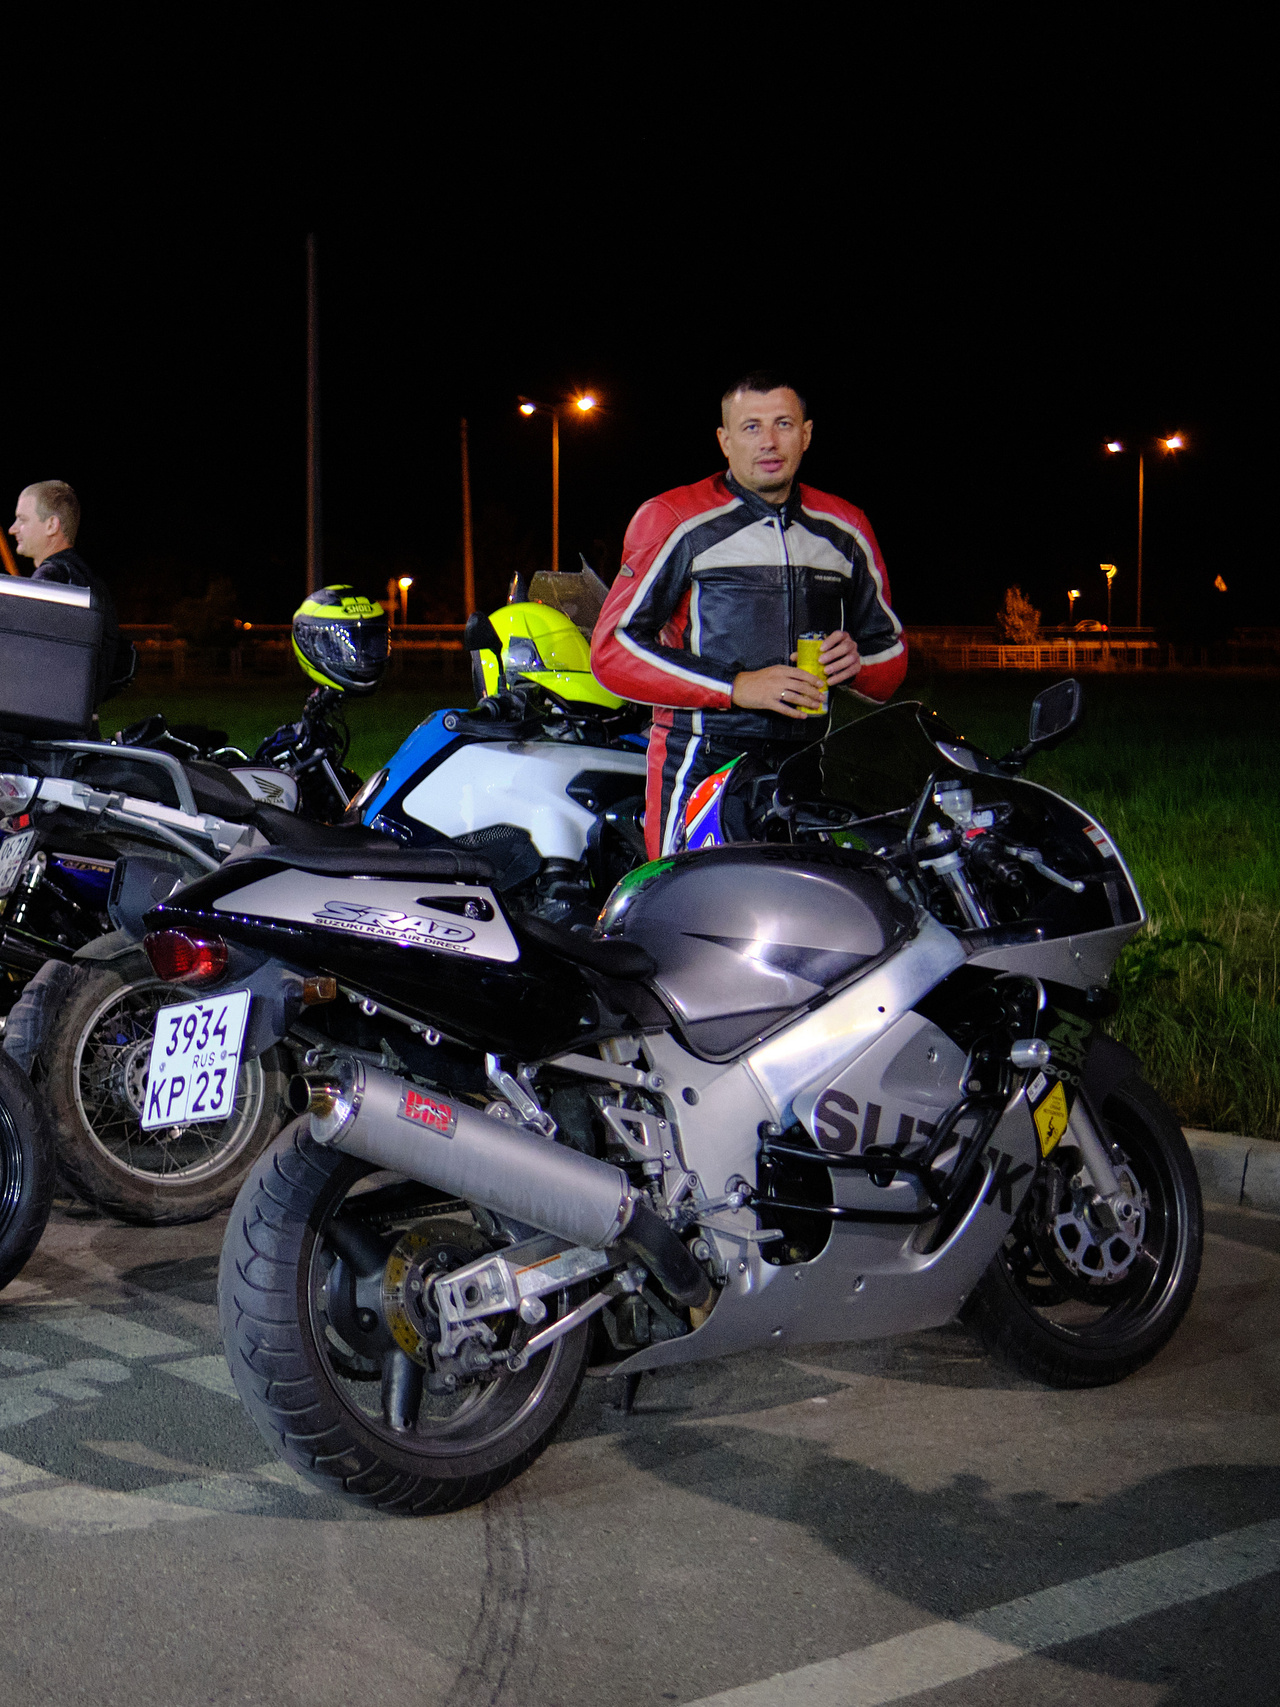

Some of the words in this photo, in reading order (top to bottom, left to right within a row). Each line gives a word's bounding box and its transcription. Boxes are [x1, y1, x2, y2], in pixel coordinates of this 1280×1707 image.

[1, 836, 29, 861] 0672
[312, 900, 476, 943] SRAD
[315, 918, 363, 934] SUZUKI
[366, 926, 396, 937] RAM
[399, 931, 421, 943] AIR
[423, 937, 470, 953] DIRECT
[166, 1005, 228, 1057] 3934
[191, 1051, 217, 1069] RUS
[191, 1067, 228, 1113] 23
